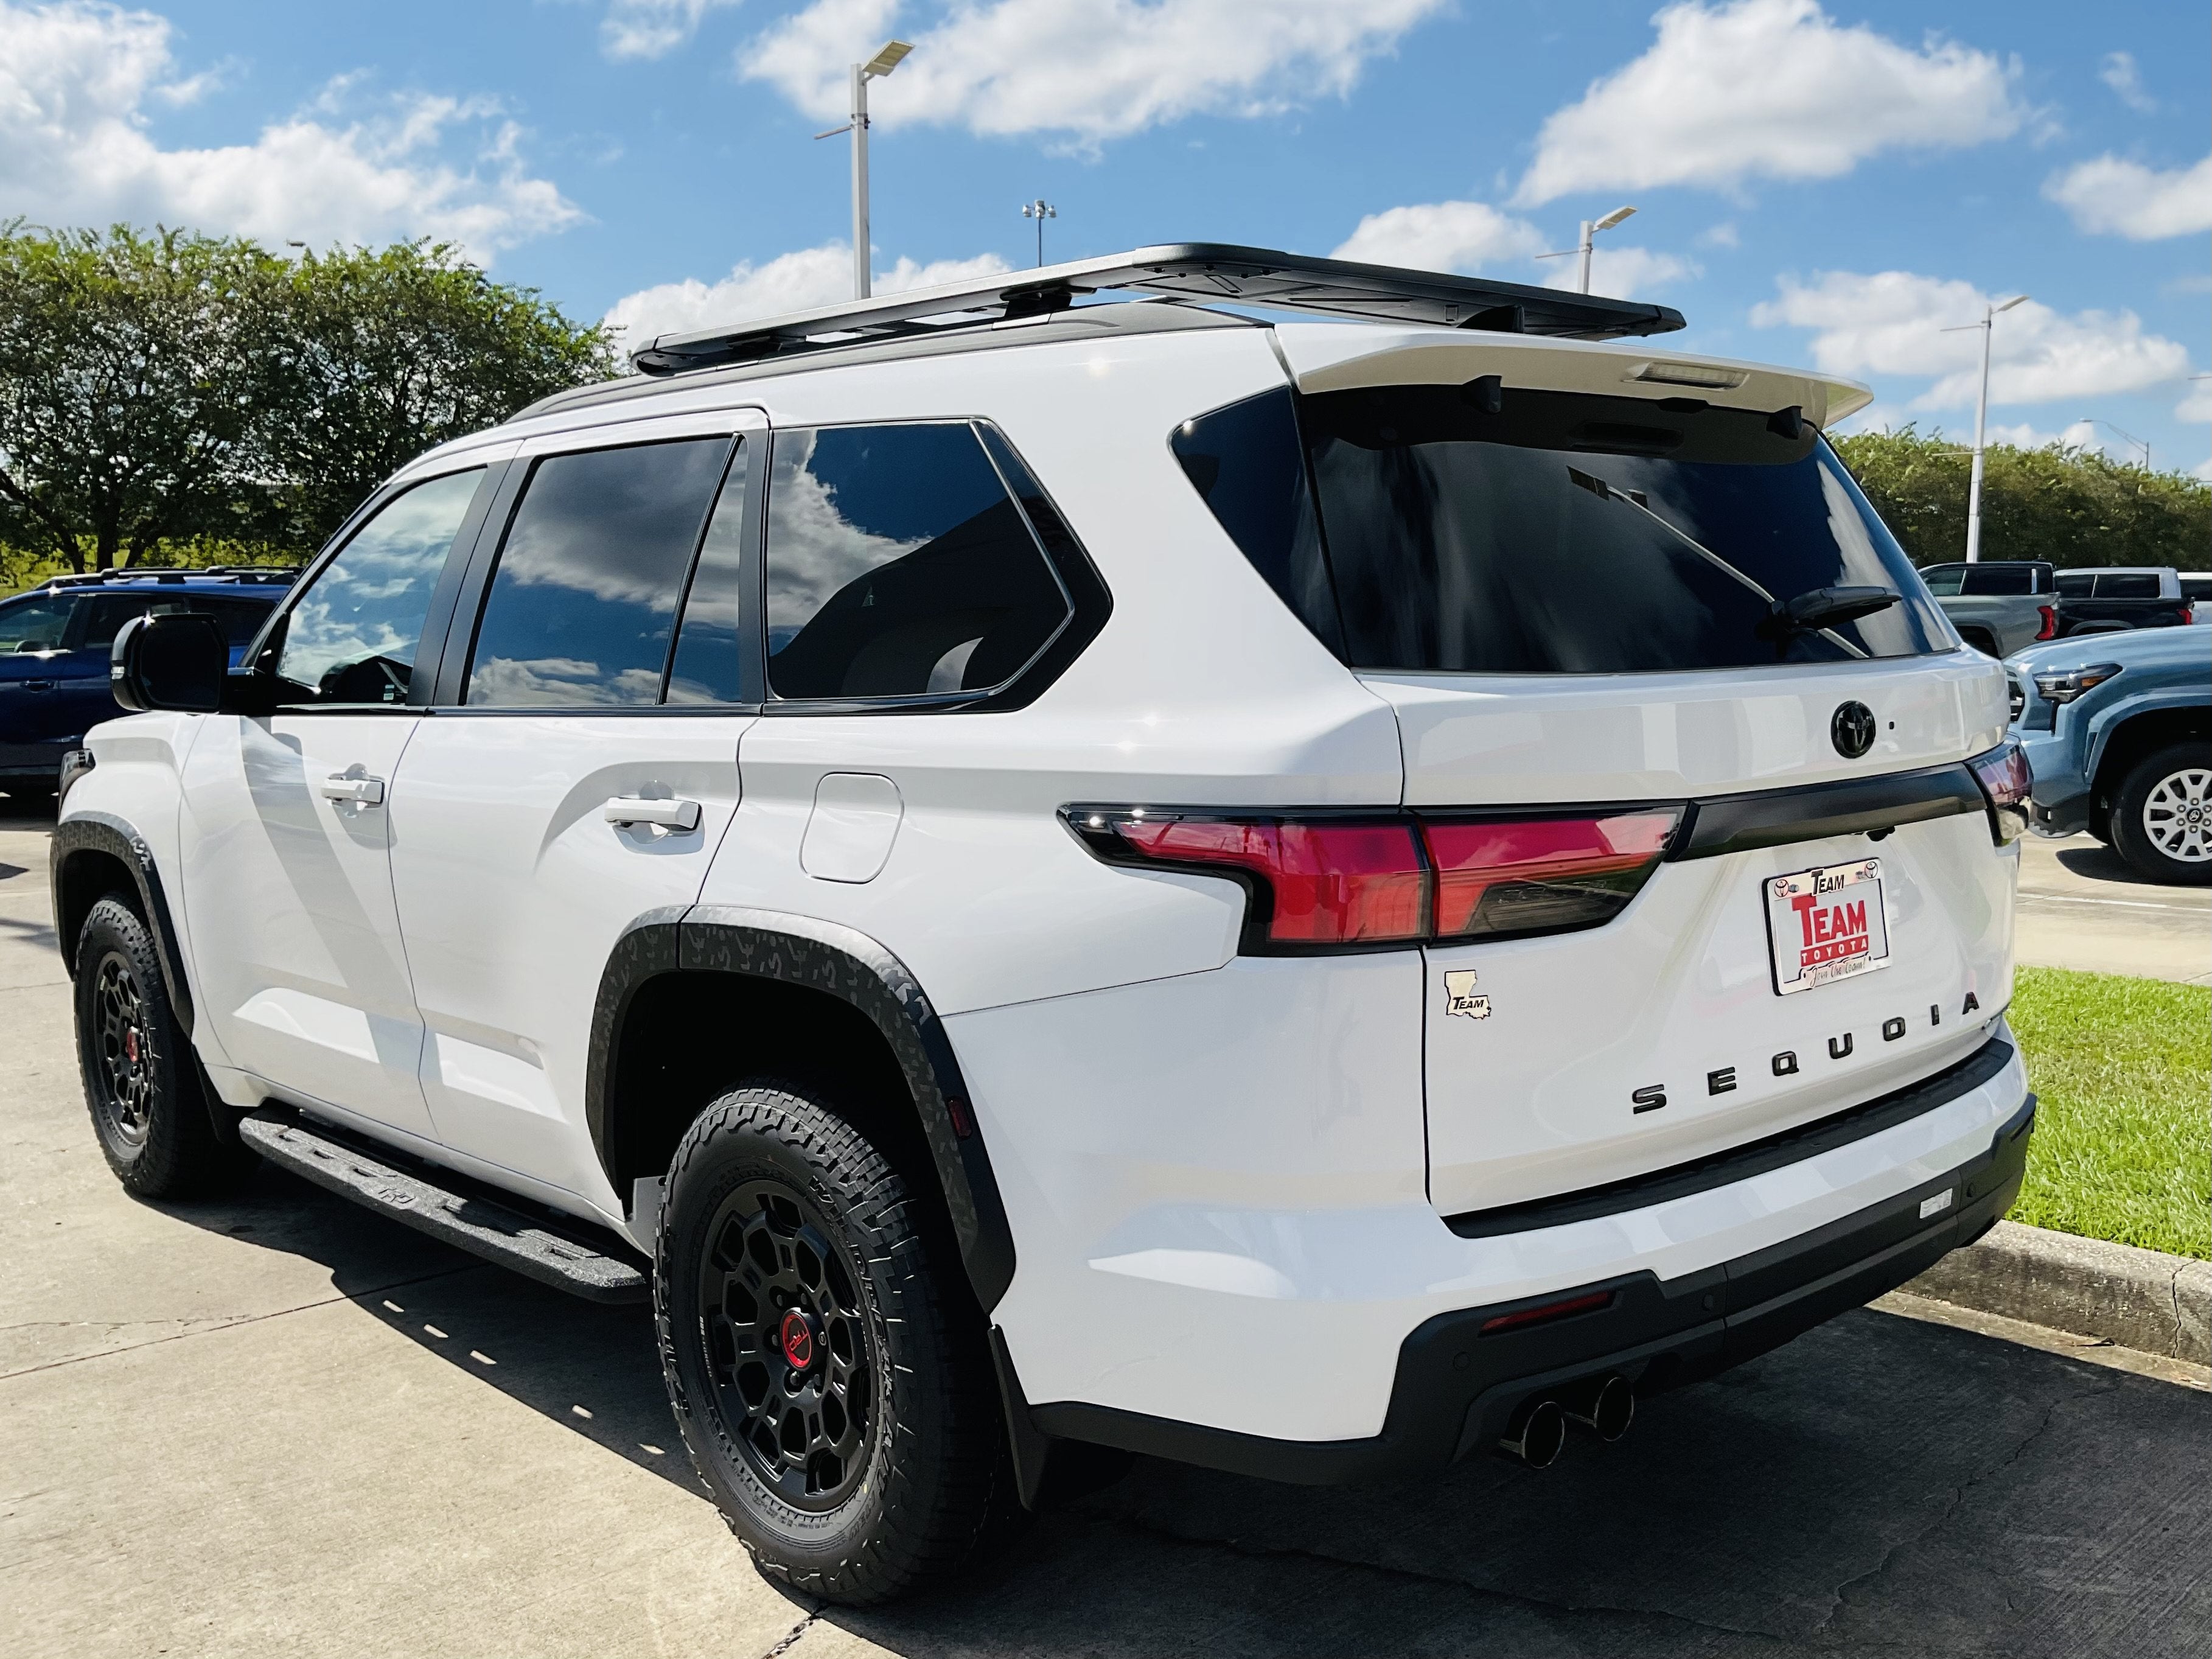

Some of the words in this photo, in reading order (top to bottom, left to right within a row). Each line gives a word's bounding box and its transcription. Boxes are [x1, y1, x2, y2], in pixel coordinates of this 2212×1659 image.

[1810, 870, 1844, 895] TEAM
[1791, 893, 1867, 948] TEAM
[1801, 938, 1868, 964] TOYOTA
[1453, 996, 1485, 1010] TEAM
[1631, 991, 1980, 1115] SEQUOIA
